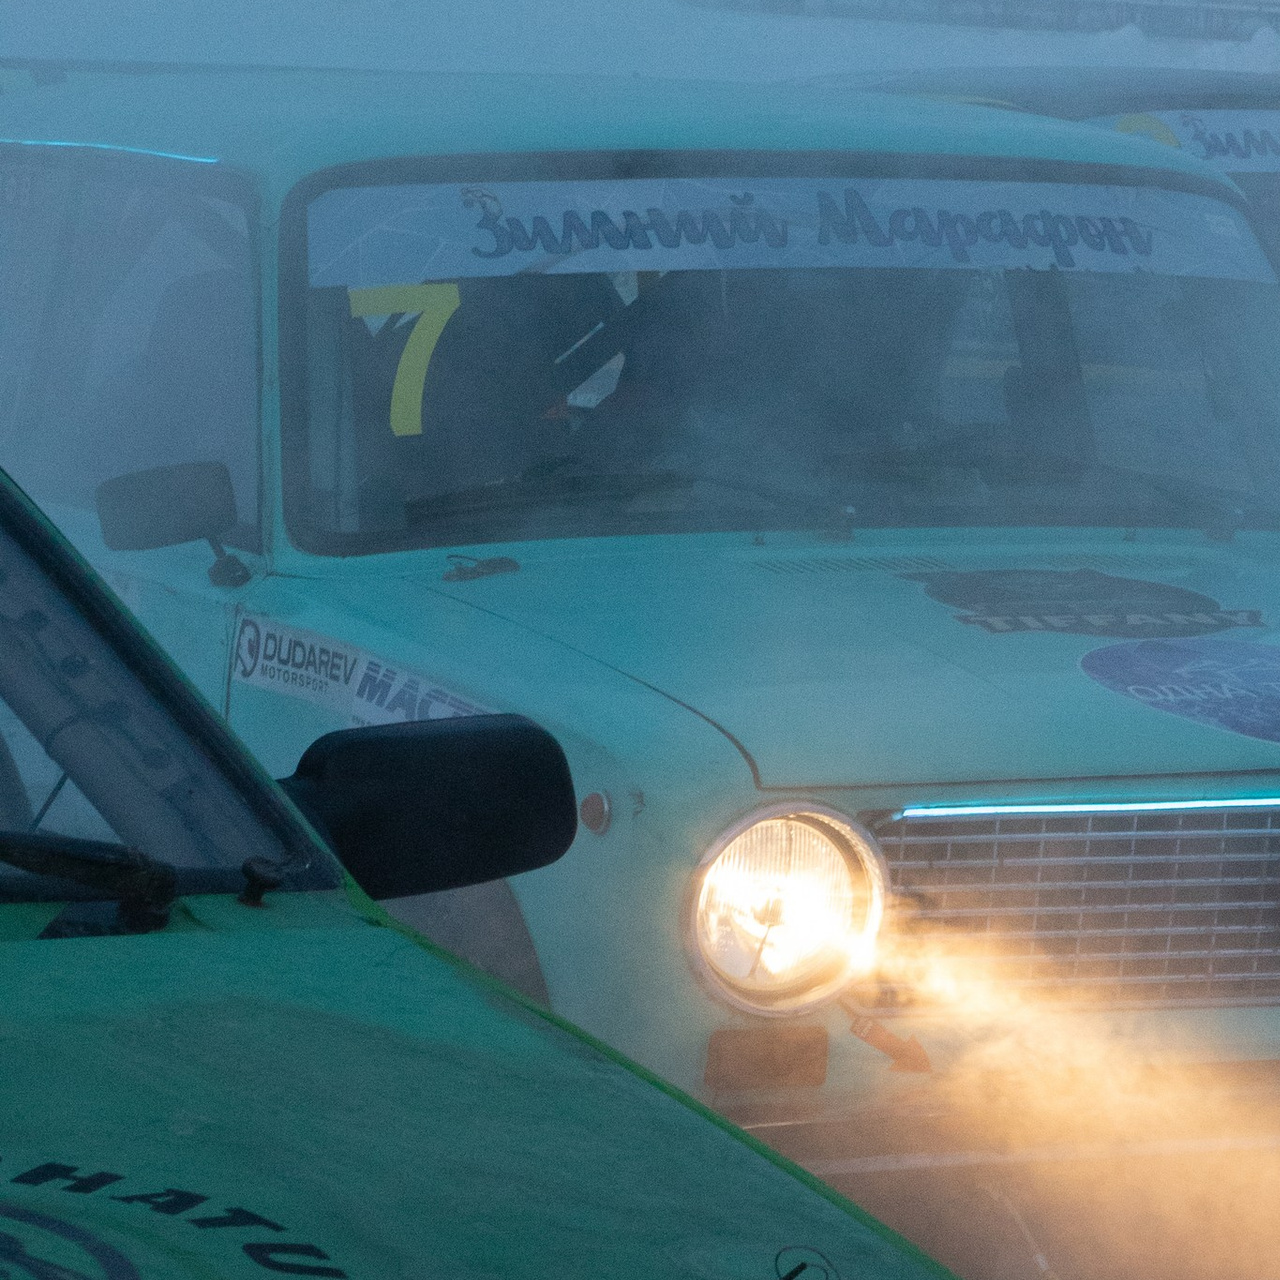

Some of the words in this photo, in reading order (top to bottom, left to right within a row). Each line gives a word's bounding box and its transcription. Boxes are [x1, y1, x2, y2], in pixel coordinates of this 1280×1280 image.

[816, 187, 1153, 268] Марафон
[348, 283, 461, 437] 7
[259, 663, 331, 695] MOTORSPORT
[261, 632, 359, 687] DUDAREV
